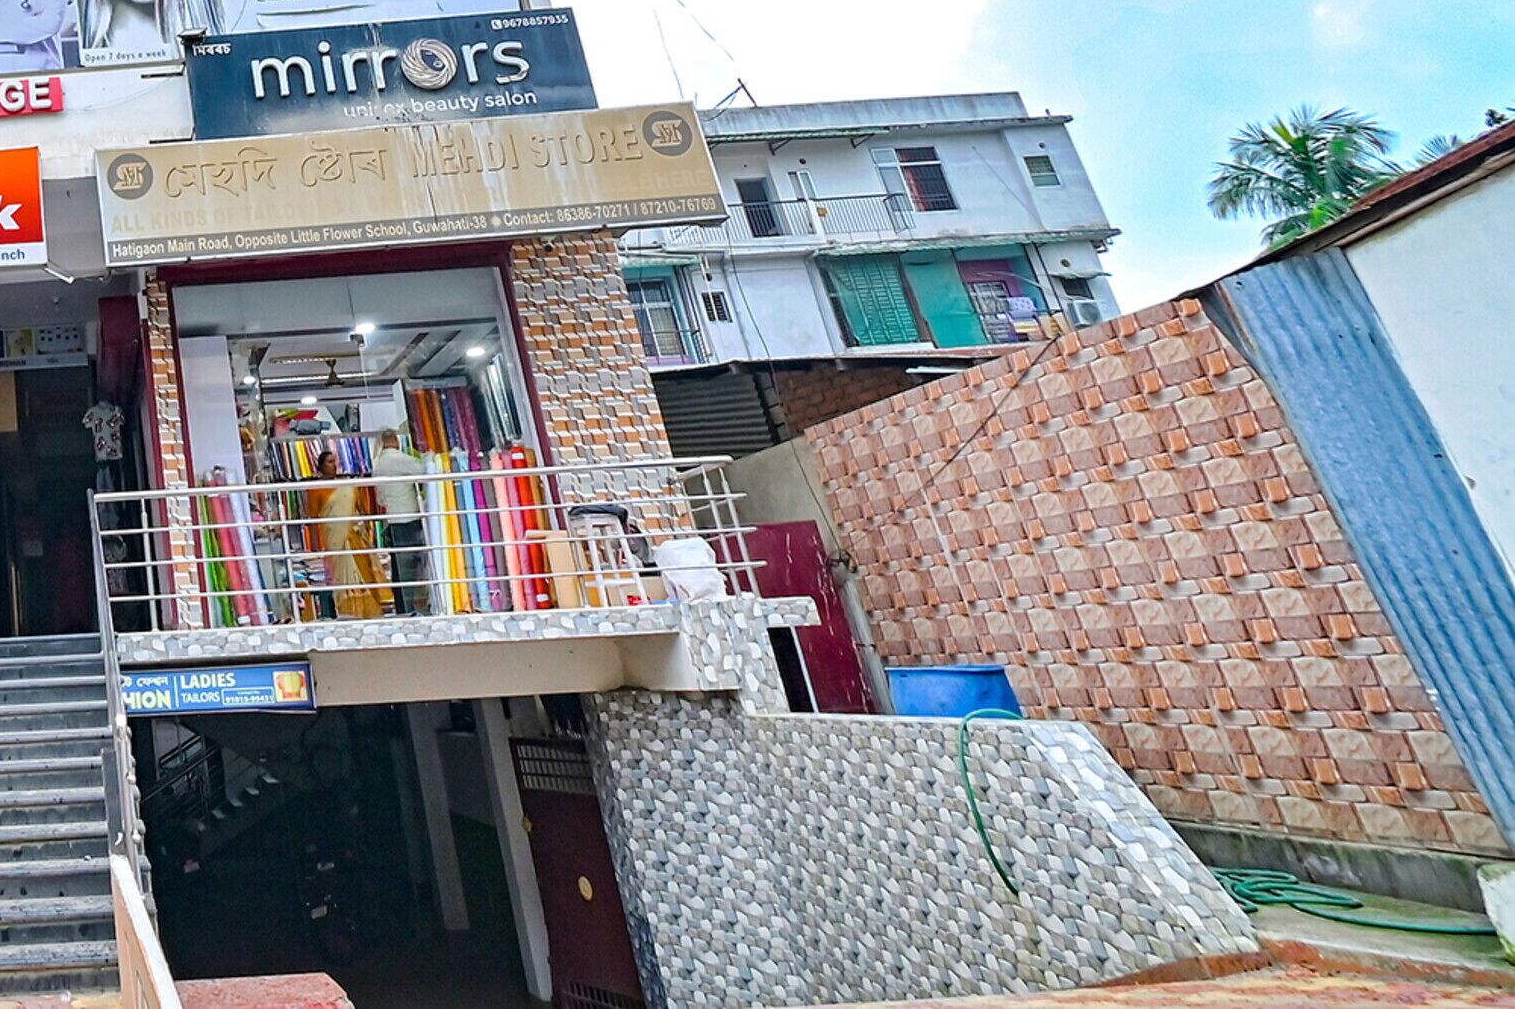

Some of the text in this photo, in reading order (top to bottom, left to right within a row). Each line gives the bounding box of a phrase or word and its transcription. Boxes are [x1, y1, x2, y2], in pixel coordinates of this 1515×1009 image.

[84, 53, 106, 64] Open
[116, 50, 136, 61] days
[146, 48, 167, 58] week
[251, 37, 530, 99] mirrors
[410, 94, 480, 116] beauty
[484, 91, 538, 109] salon
[412, 124, 643, 178] MEHDI STORE
[112, 241, 165, 259] Hatigaon
[168, 238, 196, 252] Main
[235, 232, 289, 250] Opposite
[291, 228, 321, 243] Little
[323, 225, 363, 241] Flower
[366, 221, 412, 238] School,
[413, 215, 487, 235] Guwahati-38
[504, 210, 555, 227] Contact:
[556, 203, 631, 223] 86386-70271
[640, 196, 716, 216] 87210-76769
[181, 672, 236, 689] LADIES
[181, 690, 221, 704] TAILORS
